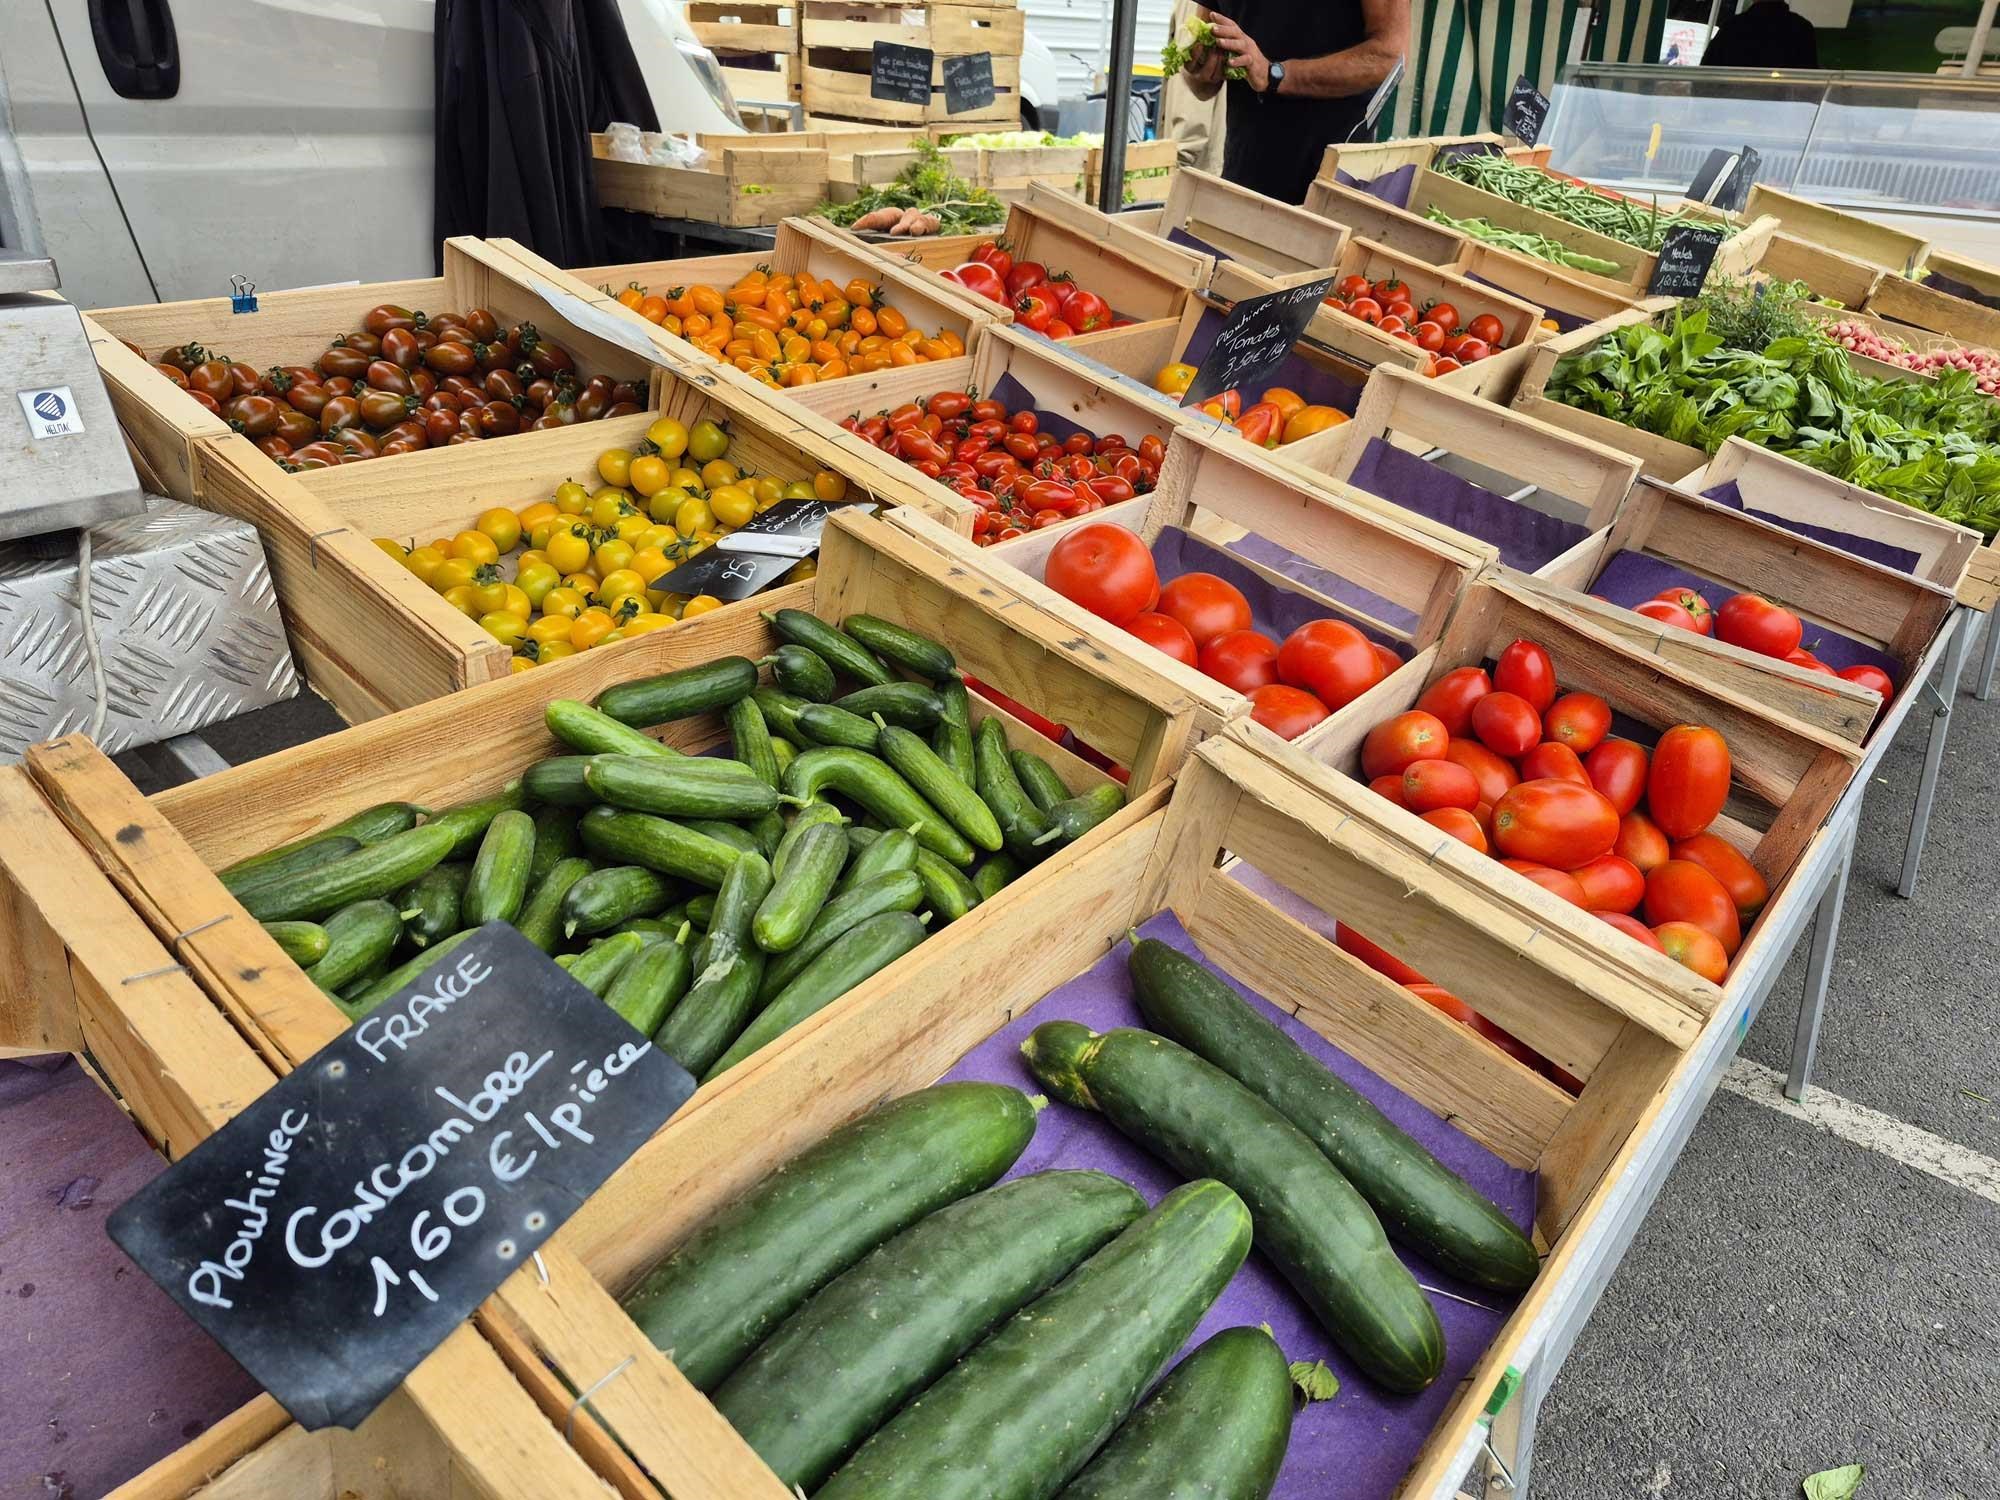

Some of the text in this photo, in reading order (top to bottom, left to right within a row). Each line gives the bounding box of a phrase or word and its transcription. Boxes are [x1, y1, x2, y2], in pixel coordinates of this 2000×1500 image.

[1691, 230, 1721, 245] FRANCE
[1288, 282, 1330, 305] FRANCE
[1226, 323, 1281, 354] Tomates
[355, 952, 493, 1064] FRANCE
[284, 1049, 555, 1269] Concombre
[187, 1107, 310, 1310] Plouhinec
